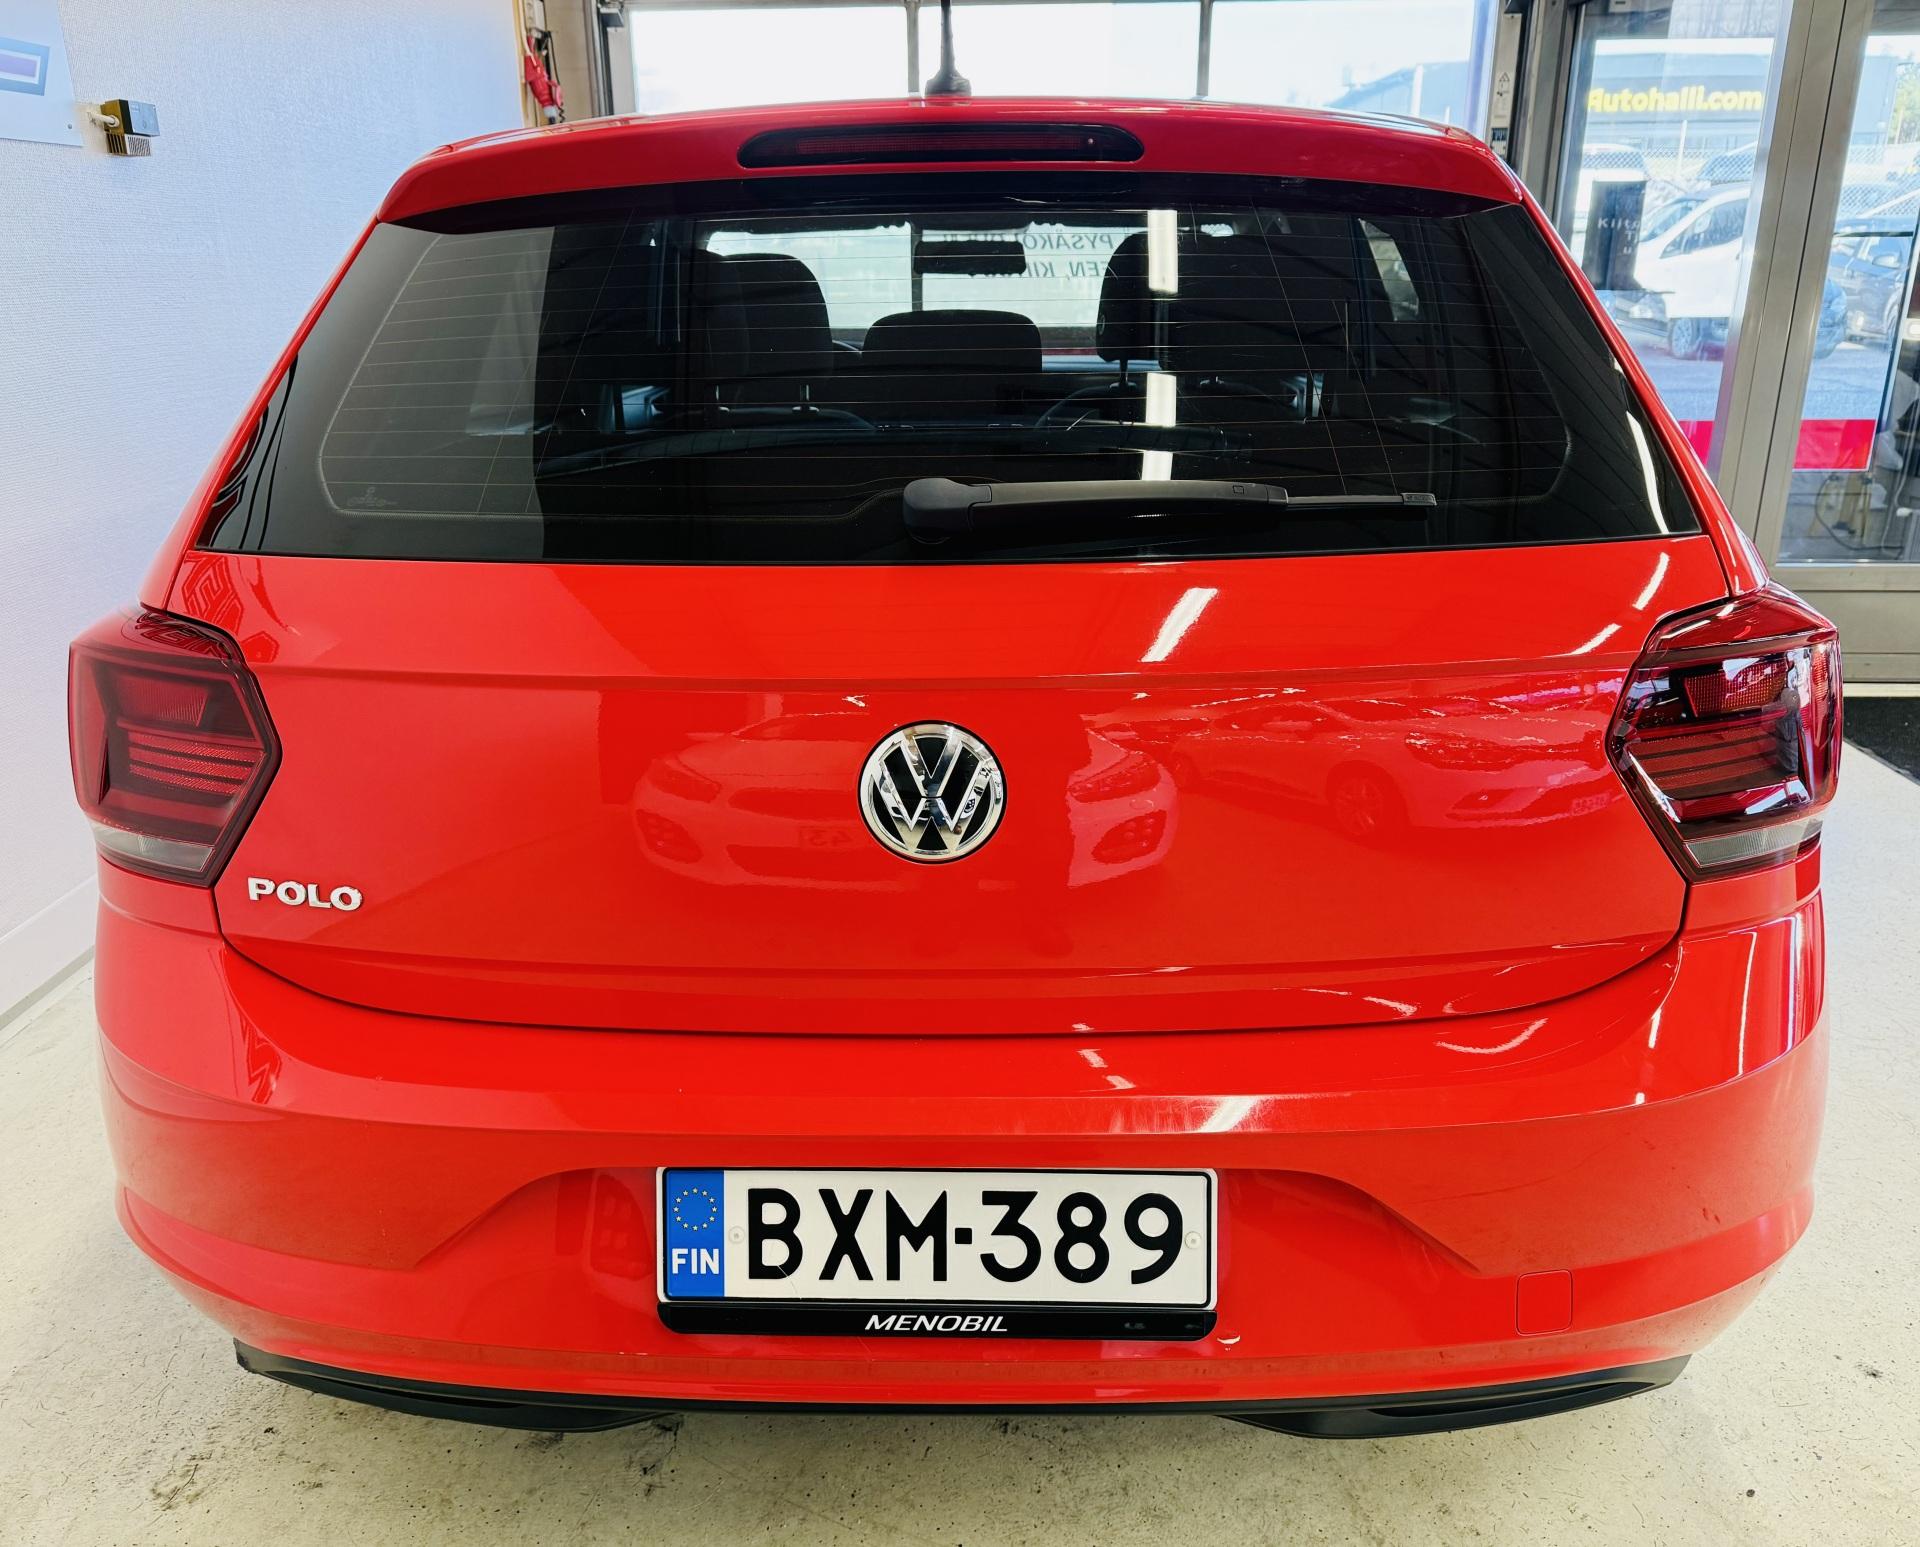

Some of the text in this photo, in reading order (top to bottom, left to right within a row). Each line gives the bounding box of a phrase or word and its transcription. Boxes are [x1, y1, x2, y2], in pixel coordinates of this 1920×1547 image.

[1588, 85, 1762, 112] Autohalli.com
[247, 877, 362, 911] POLO
[748, 1188, 1184, 1285] BXM-389
[672, 1248, 719, 1275] FIN
[865, 1314, 1008, 1333] MENOBIL
